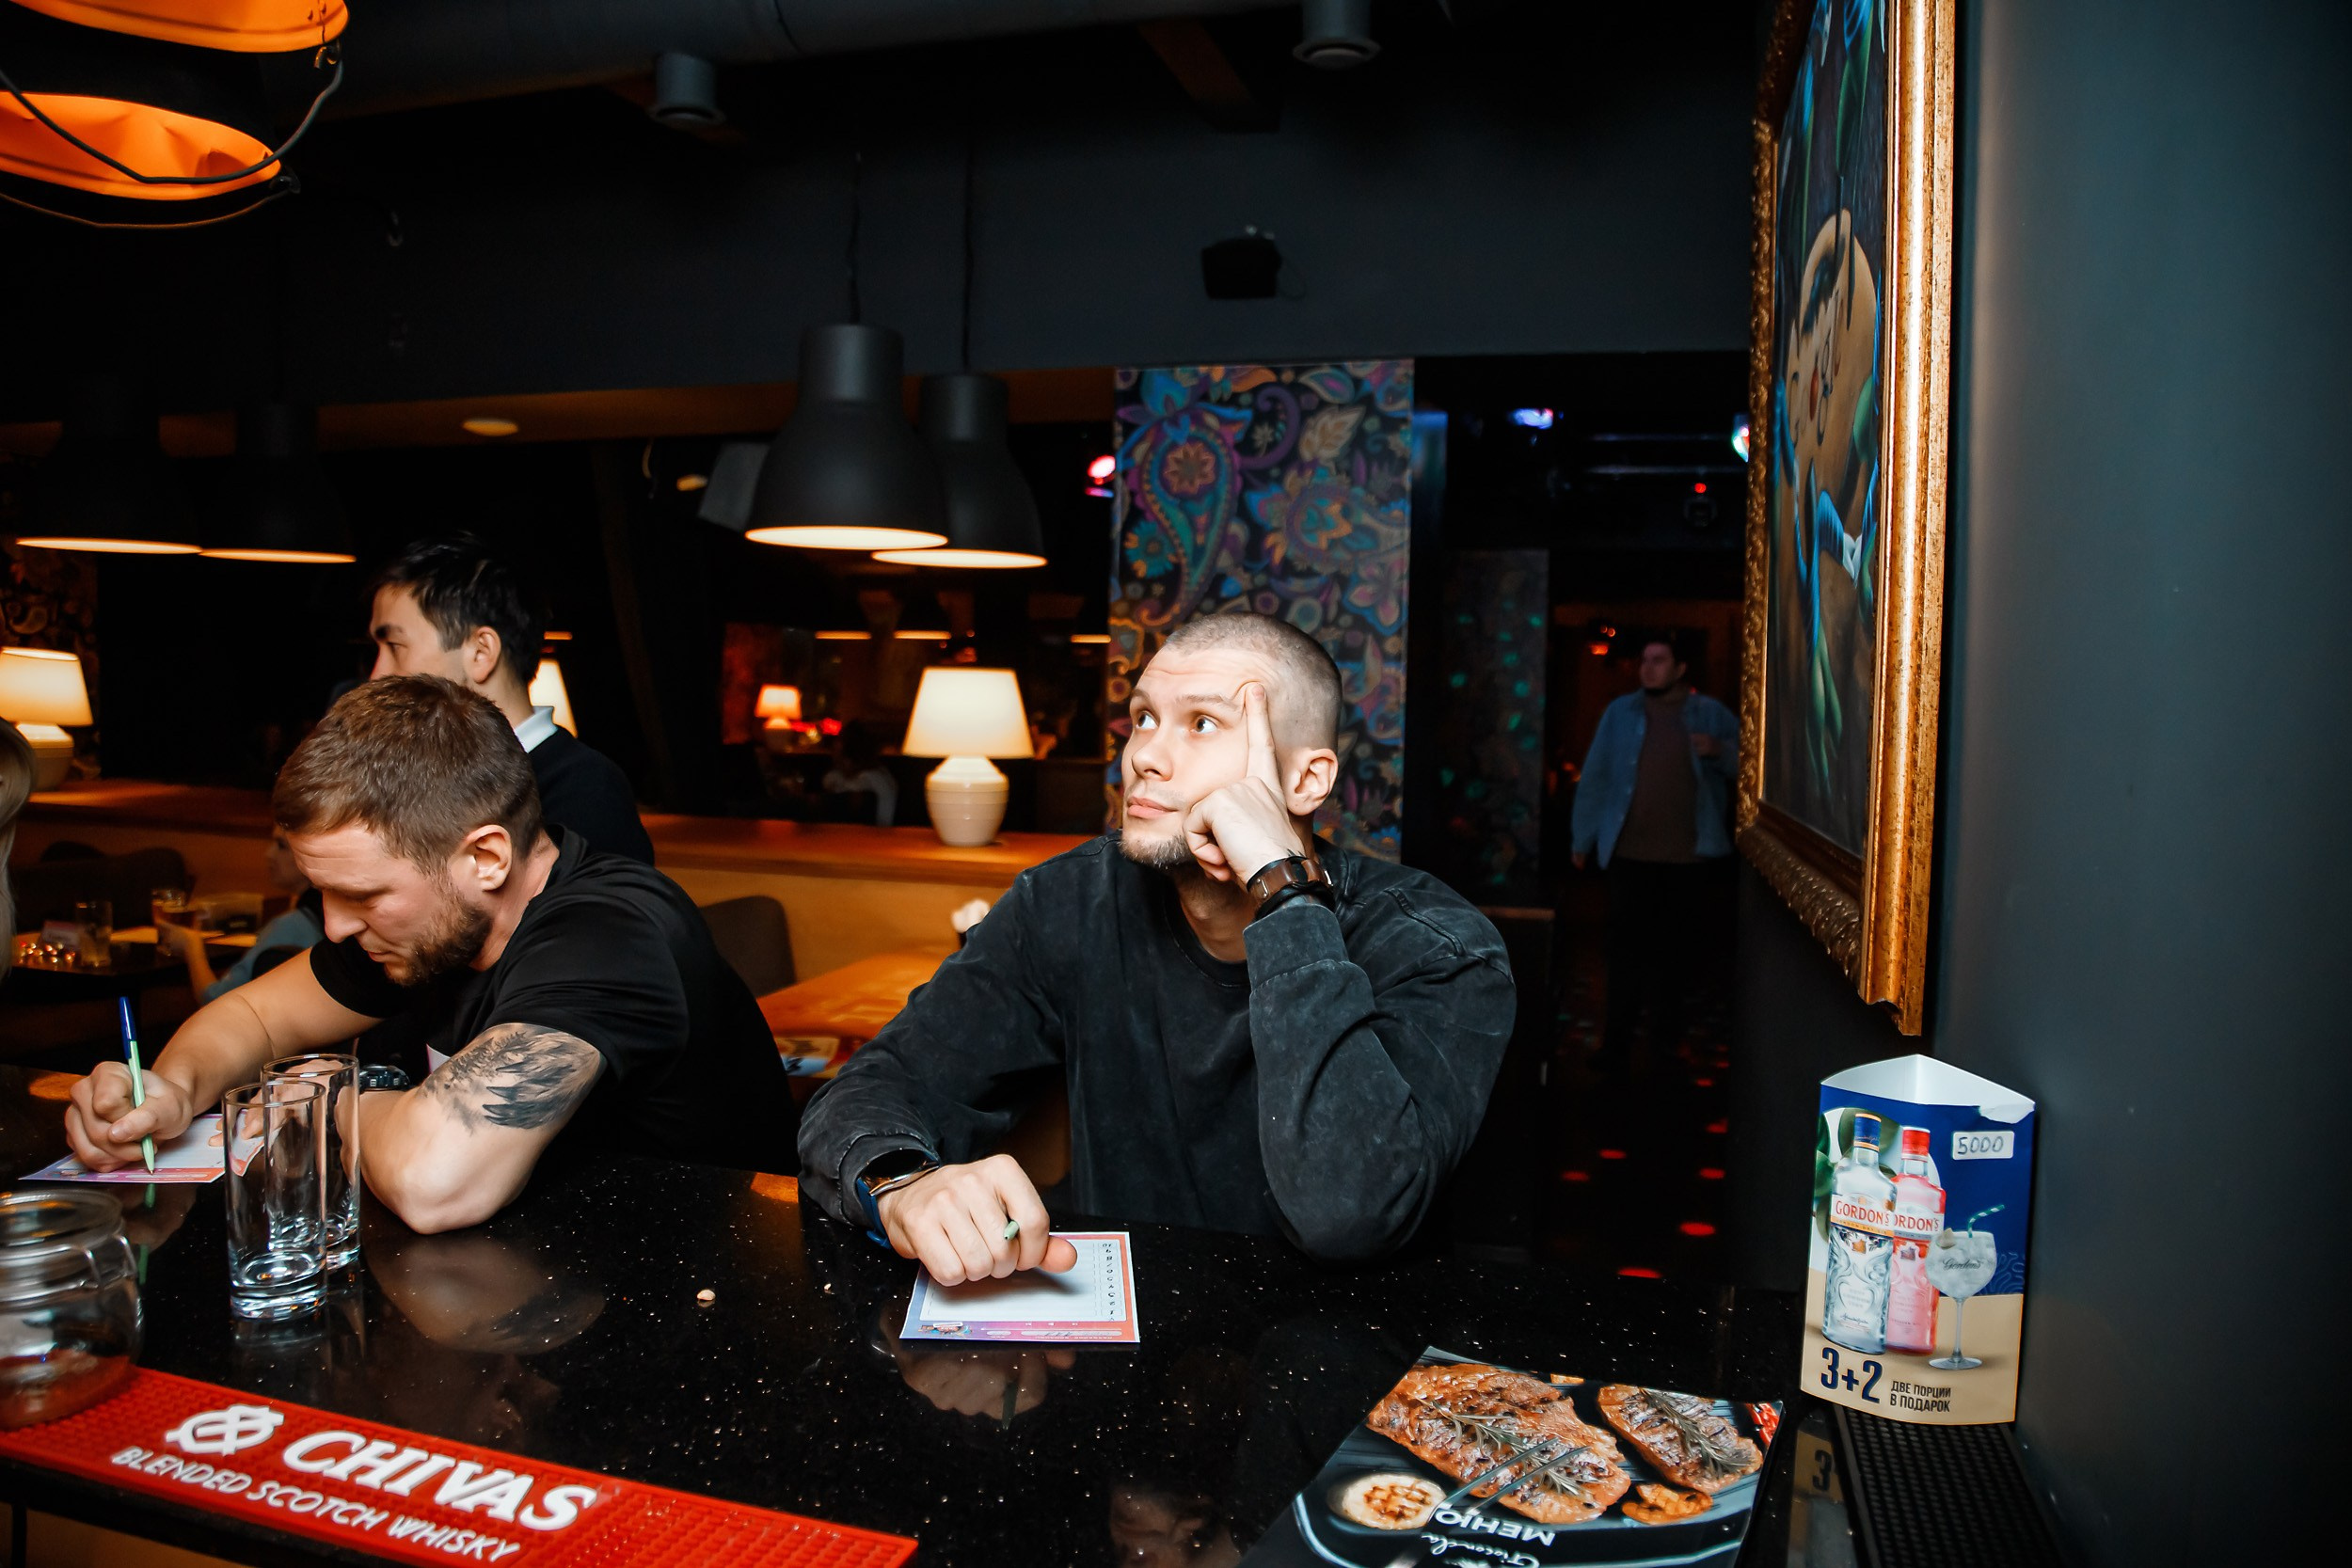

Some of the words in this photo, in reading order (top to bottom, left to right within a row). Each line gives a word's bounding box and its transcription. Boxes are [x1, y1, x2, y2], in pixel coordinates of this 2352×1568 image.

[1957, 1135, 2004, 1155] 5000
[1836, 1200, 1890, 1227] GORDON'S
[1894, 1214, 1940, 1232] ORDON'S
[1820, 1346, 1883, 1404] 3+2
[1890, 1393, 1898, 1407] В
[1899, 1394, 1951, 1413] ПОДАРОК
[1891, 1380, 1912, 1395] ДВЕ
[1913, 1385, 1952, 1400] ПОРЦИИ
[283, 1429, 598, 1531] CHIVAS
[111, 1445, 253, 1494] BLENDED
[246, 1480, 390, 1531] SCOTCH
[387, 1514, 521, 1562] WHISKY
[1435, 1509, 1556, 1547] МЕНЮ
